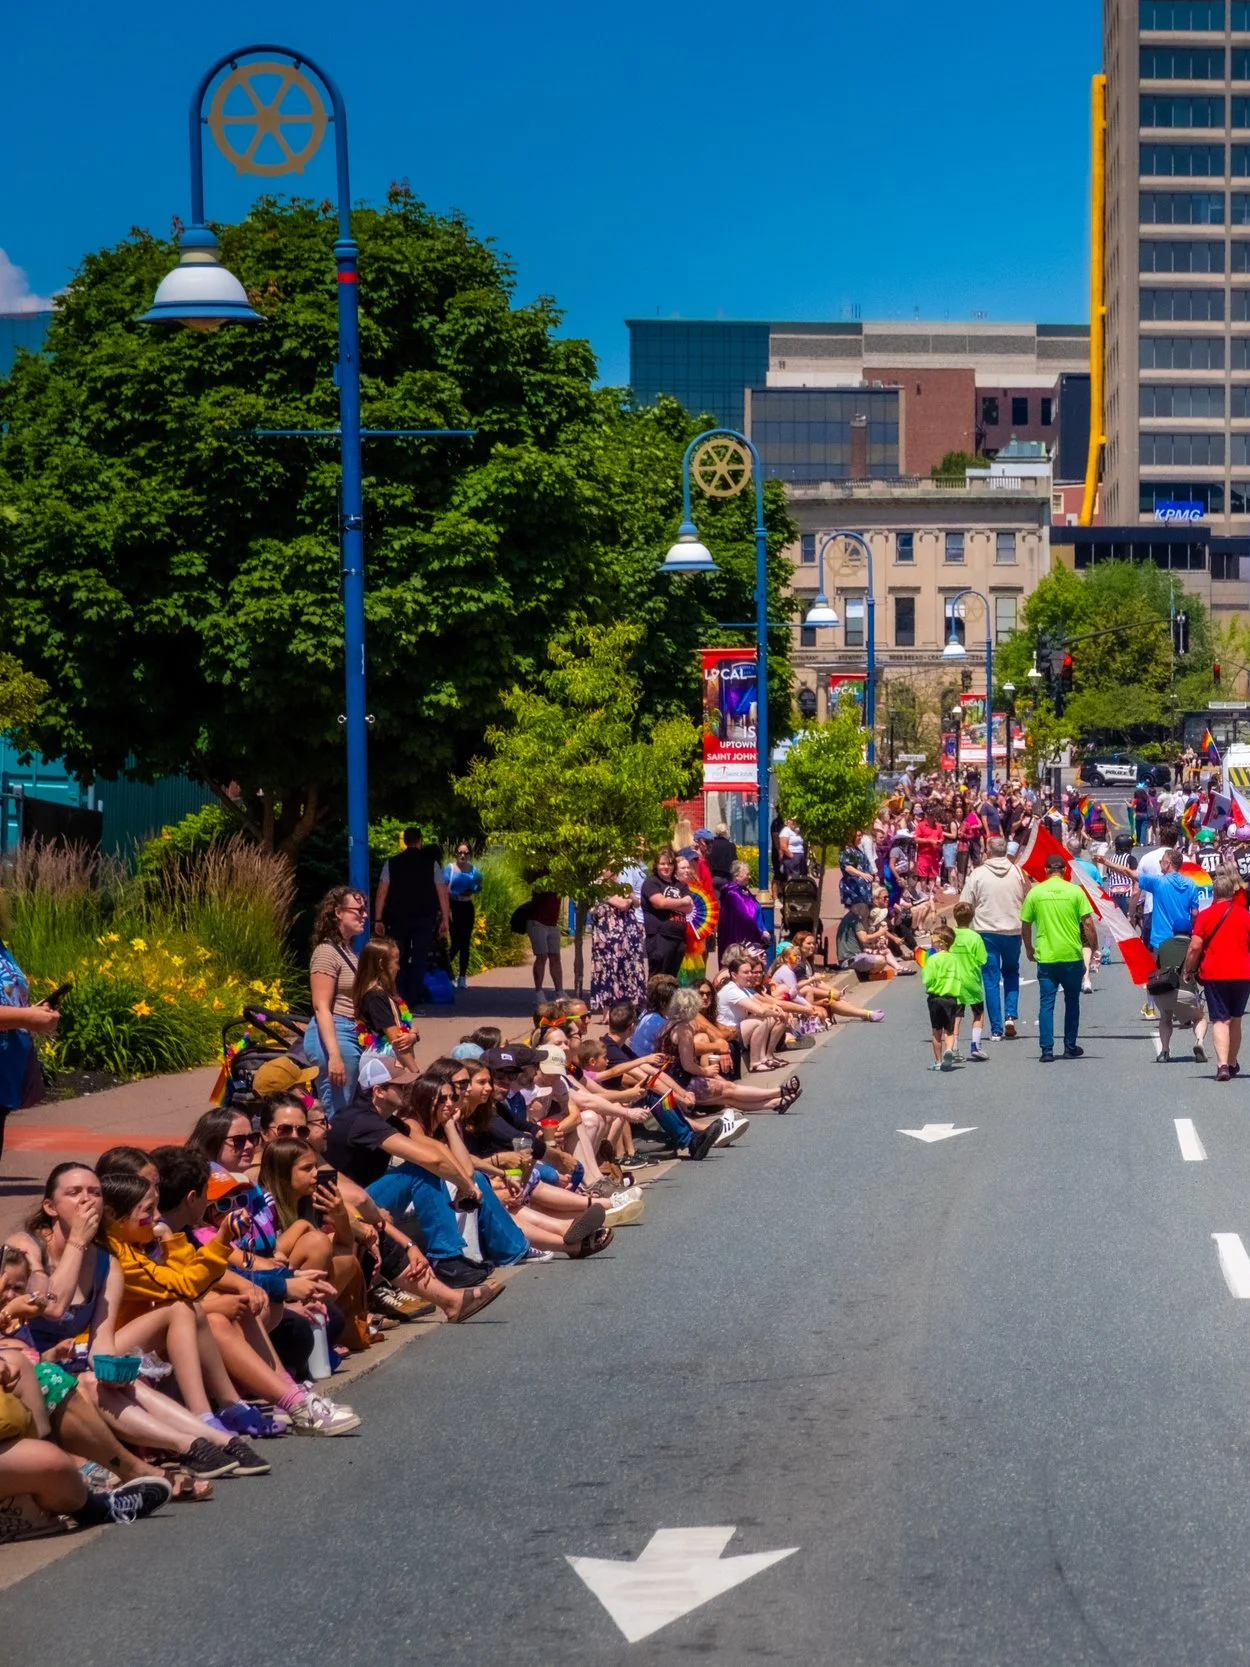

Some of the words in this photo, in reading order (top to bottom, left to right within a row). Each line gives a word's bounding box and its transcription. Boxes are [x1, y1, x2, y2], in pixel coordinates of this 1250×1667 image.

[1154, 509, 1201, 521] KPMG
[704, 668, 747, 680] LOCAL
[743, 726, 756, 738] IS
[720, 741, 756, 749] UPTOWN
[707, 753, 731, 761] SAINT
[732, 753, 756, 761] JOHN
